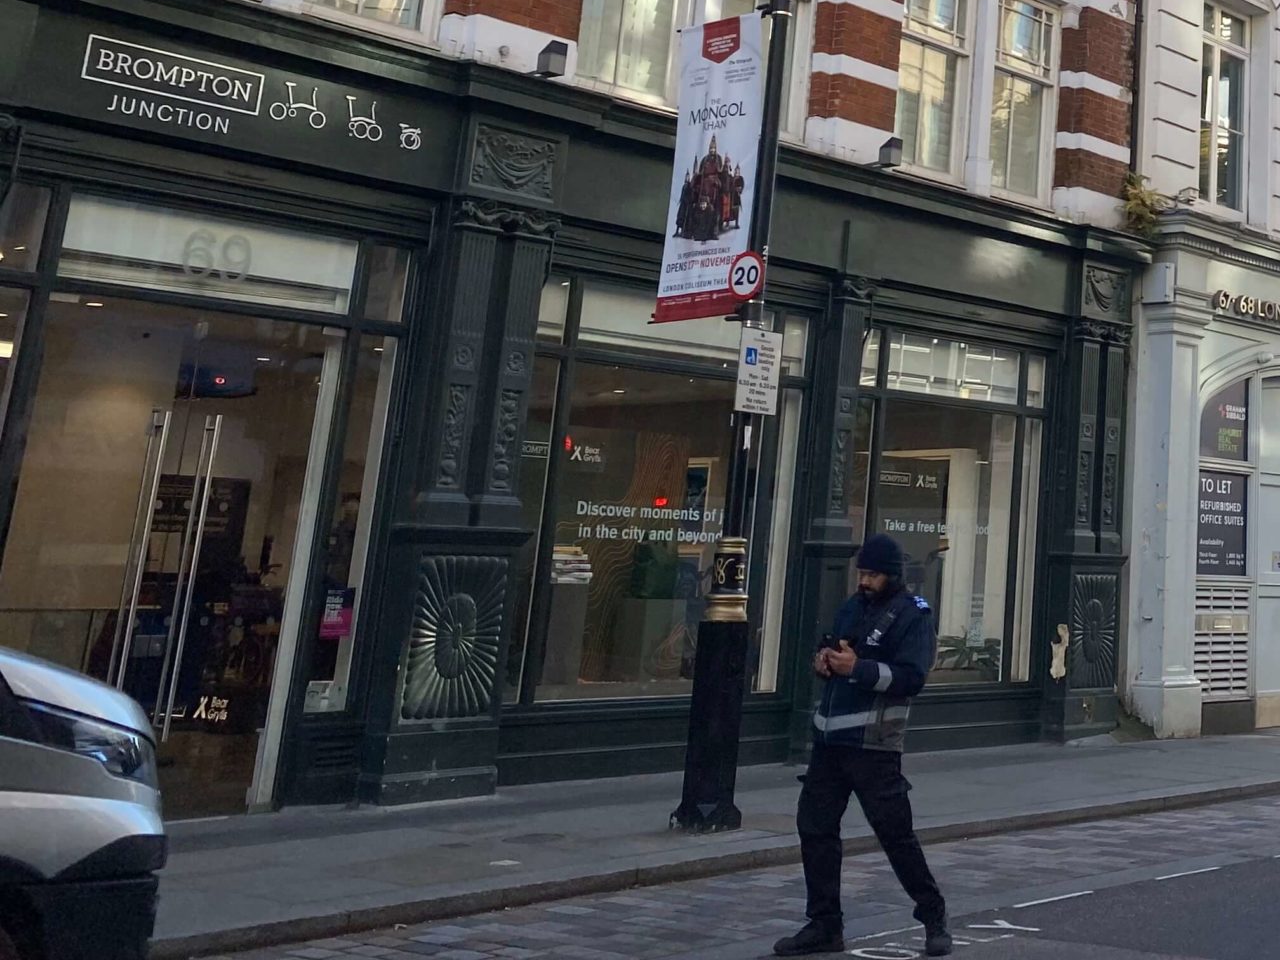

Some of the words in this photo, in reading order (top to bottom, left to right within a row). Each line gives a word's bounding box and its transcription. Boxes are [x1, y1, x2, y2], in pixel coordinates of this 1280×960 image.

[96, 48, 252, 103] BROMPTON
[107, 95, 230, 134] JUNCTION
[689, 101, 747, 127] MONGOL
[703, 120, 727, 132] KHAN
[183, 228, 252, 282] 69
[666, 262, 687, 274] OPENS
[700, 255, 739, 268] NOVEMBE
[734, 265, 759, 286] 20
[663, 283, 684, 293] LONDON
[685, 280, 712, 290] COLISEUM
[1226, 404, 1246, 413] GRAHAM
[585, 446, 600, 454] Bear
[583, 454, 601, 463] Grylls
[1201, 478, 1214, 492] TO
[1216, 480, 1232, 494] LET
[576, 500, 636, 518] Discover
[640, 507, 700, 521] moments
[704, 508, 717, 522] of
[1200, 500, 1241, 512] REFURBISHED
[884, 518, 906, 531] Take
[909, 522, 915, 532] a
[917, 521, 935, 533] free
[1200, 513, 1222, 525] OFFICE
[1224, 515, 1244, 526] SUITES
[578, 523, 590, 538] in
[596, 524, 618, 539] the
[622, 525, 646, 543] city
[650, 528, 673, 542] and
[677, 528, 723, 545] beyond
[211, 696, 229, 708] Bear
[207, 709, 228, 723] Grylls
